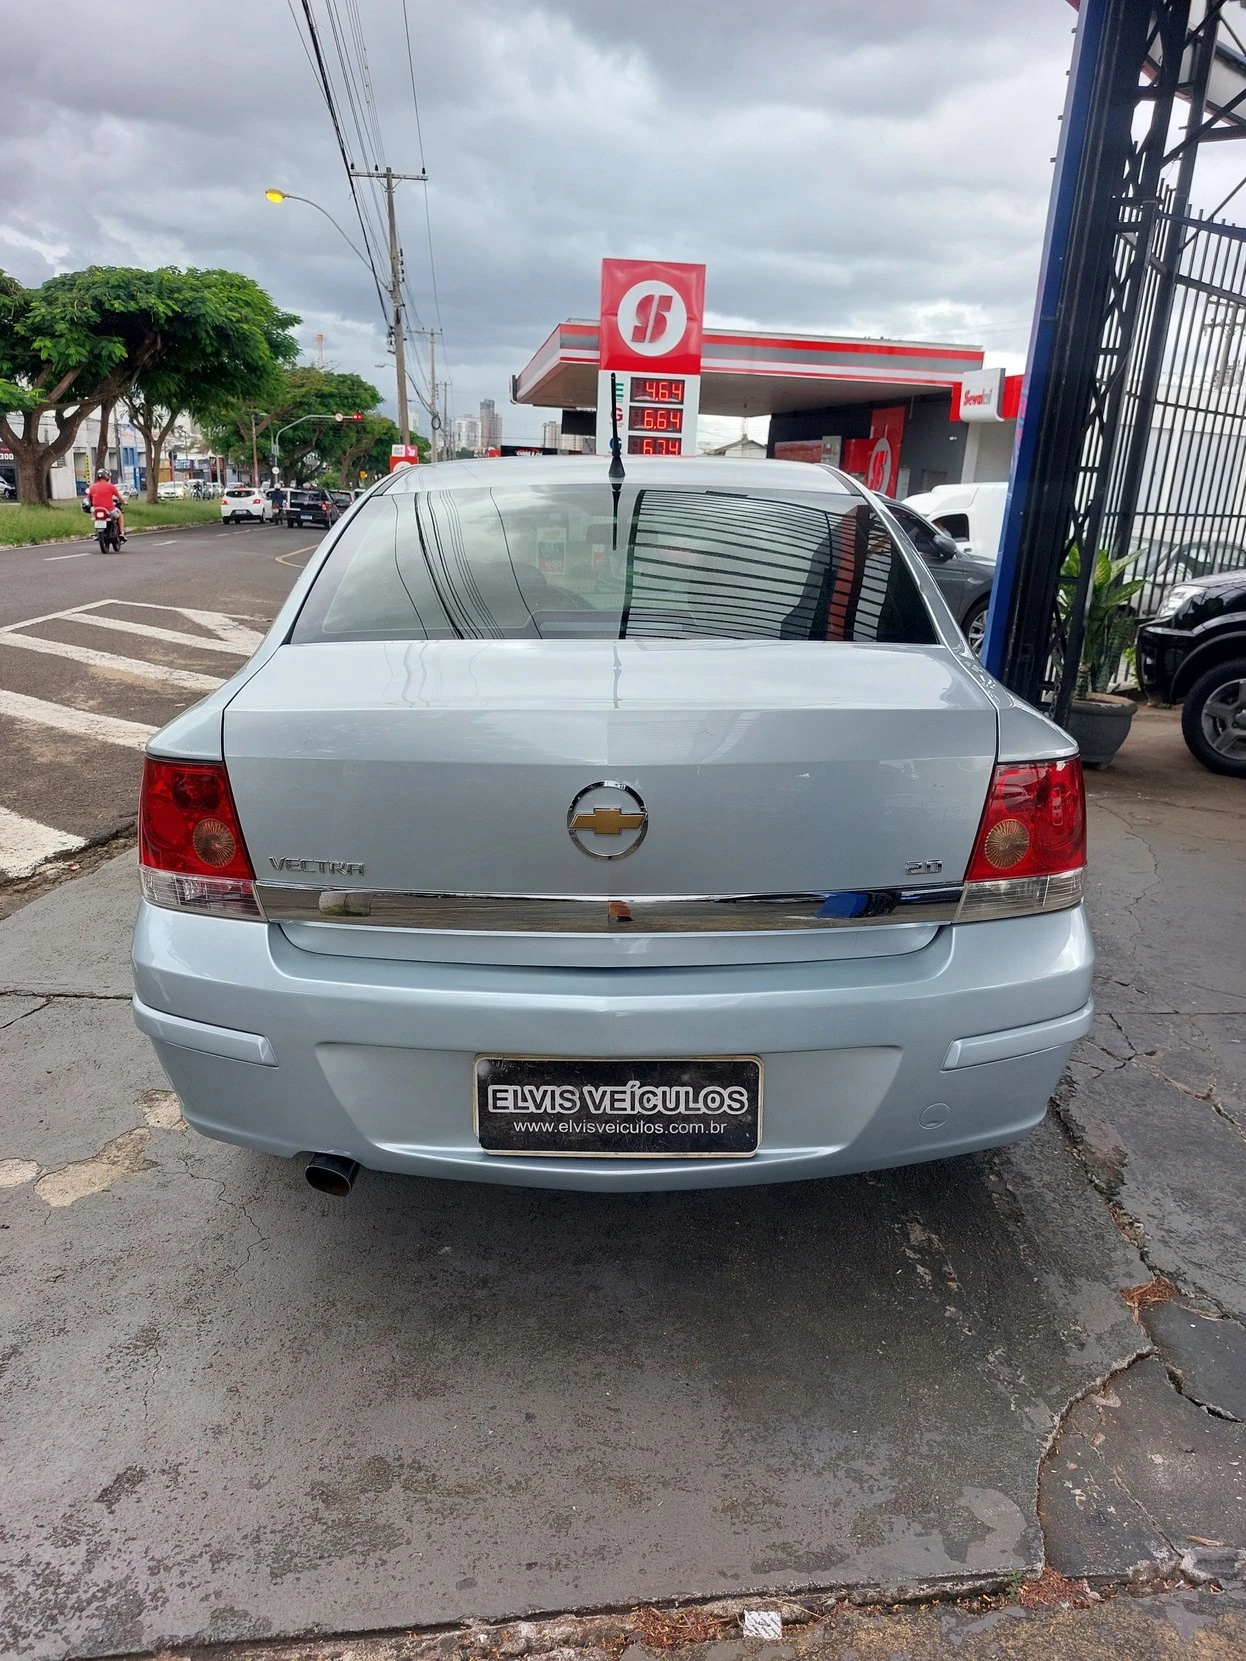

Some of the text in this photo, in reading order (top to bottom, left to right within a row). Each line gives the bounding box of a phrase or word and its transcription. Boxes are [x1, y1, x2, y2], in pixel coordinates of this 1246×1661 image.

[267, 856, 365, 877] VECTRA
[488, 1080, 749, 1116] ELVIS VEÍCULOS
[513, 1119, 727, 1135] www.elvisveiculos.com.br
